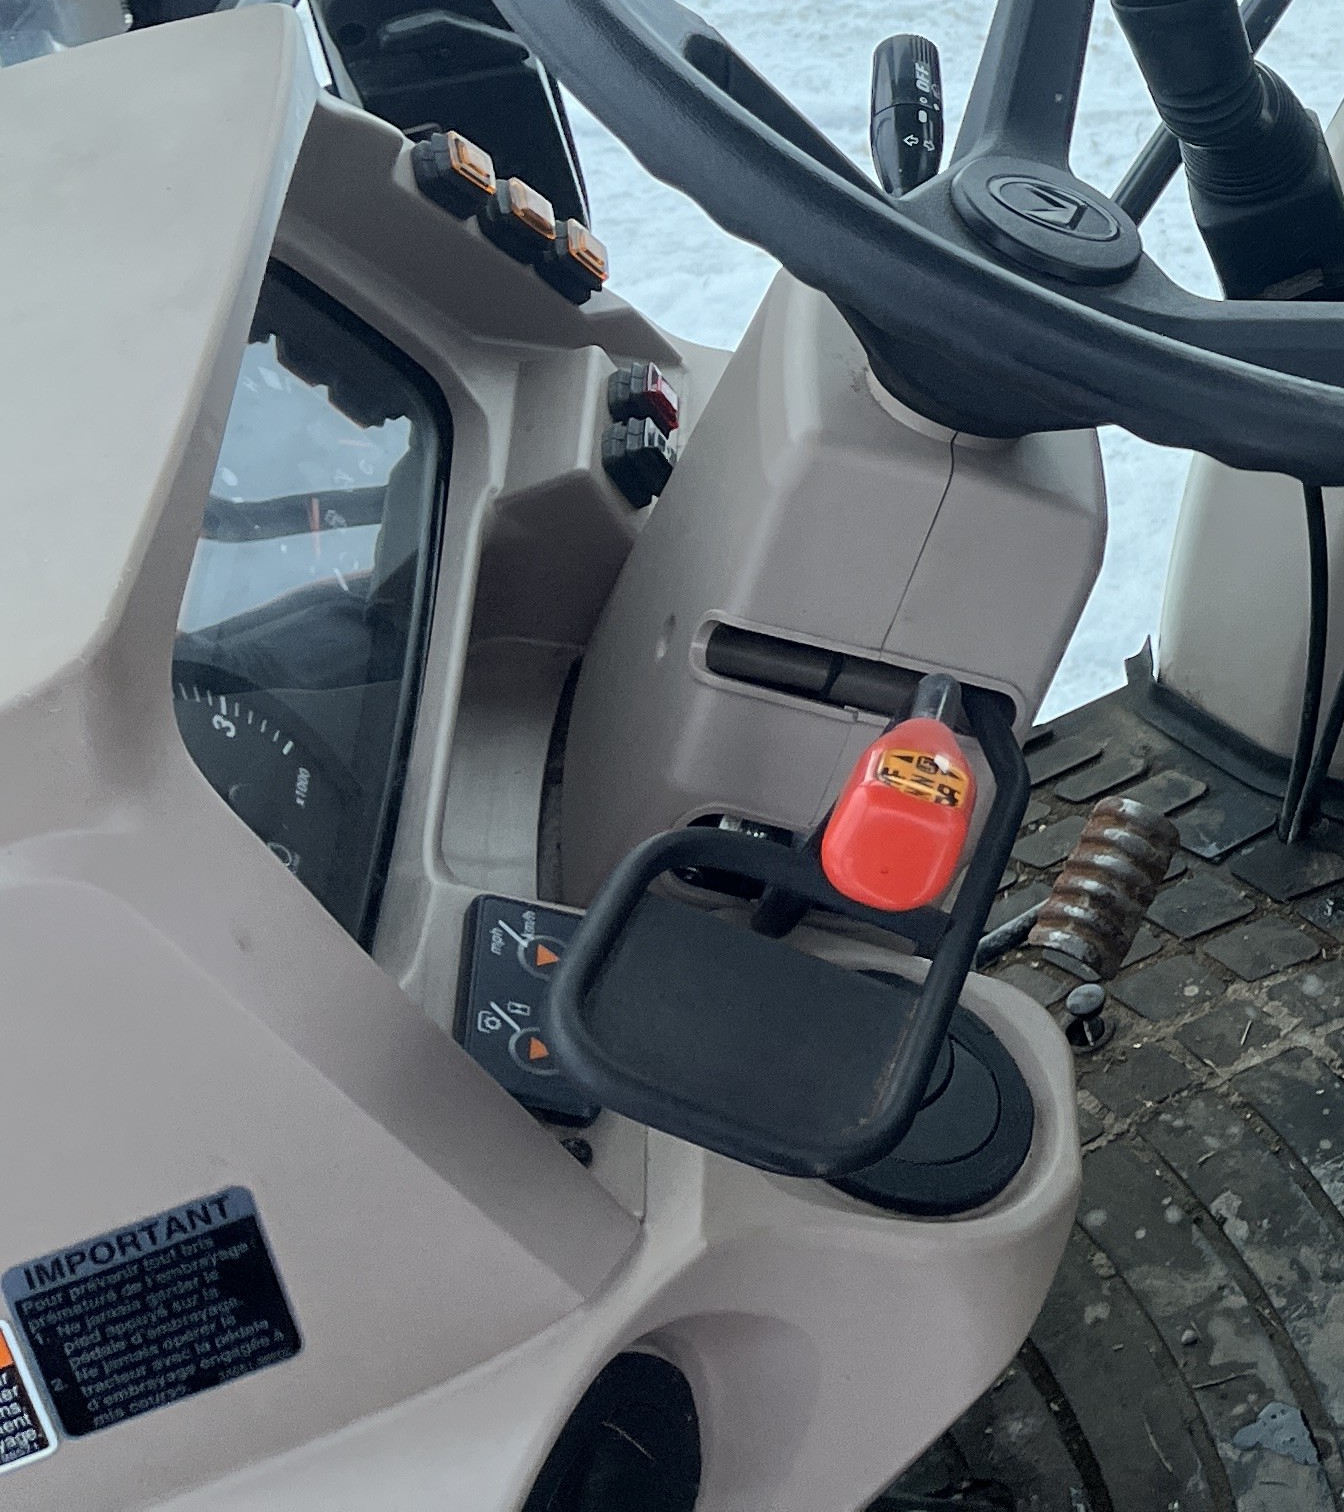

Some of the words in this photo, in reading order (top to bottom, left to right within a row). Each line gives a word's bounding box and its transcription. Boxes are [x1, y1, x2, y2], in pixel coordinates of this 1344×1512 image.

[915, 62, 930, 93] OFF
[212, 714, 236, 738] 3
[489, 927, 505, 956] mph
[25, 1196, 228, 1289] IMPORTANT
[24, 1292, 63, 1314] Pour
[122, 1283, 142, 1296] de
[35, 1332, 50, 1345] 1.
[57, 1323, 80, 1336] Ne
[85, 1300, 141, 1332] jamais
[64, 1328, 101, 1356] pied
[172, 1295, 198, 1312] sur
[51, 1378, 68, 1392] 2.
[75, 1368, 98, 1382] Ne
[102, 1345, 159, 1375] jamais
[152, 1350, 190, 1370] avec
